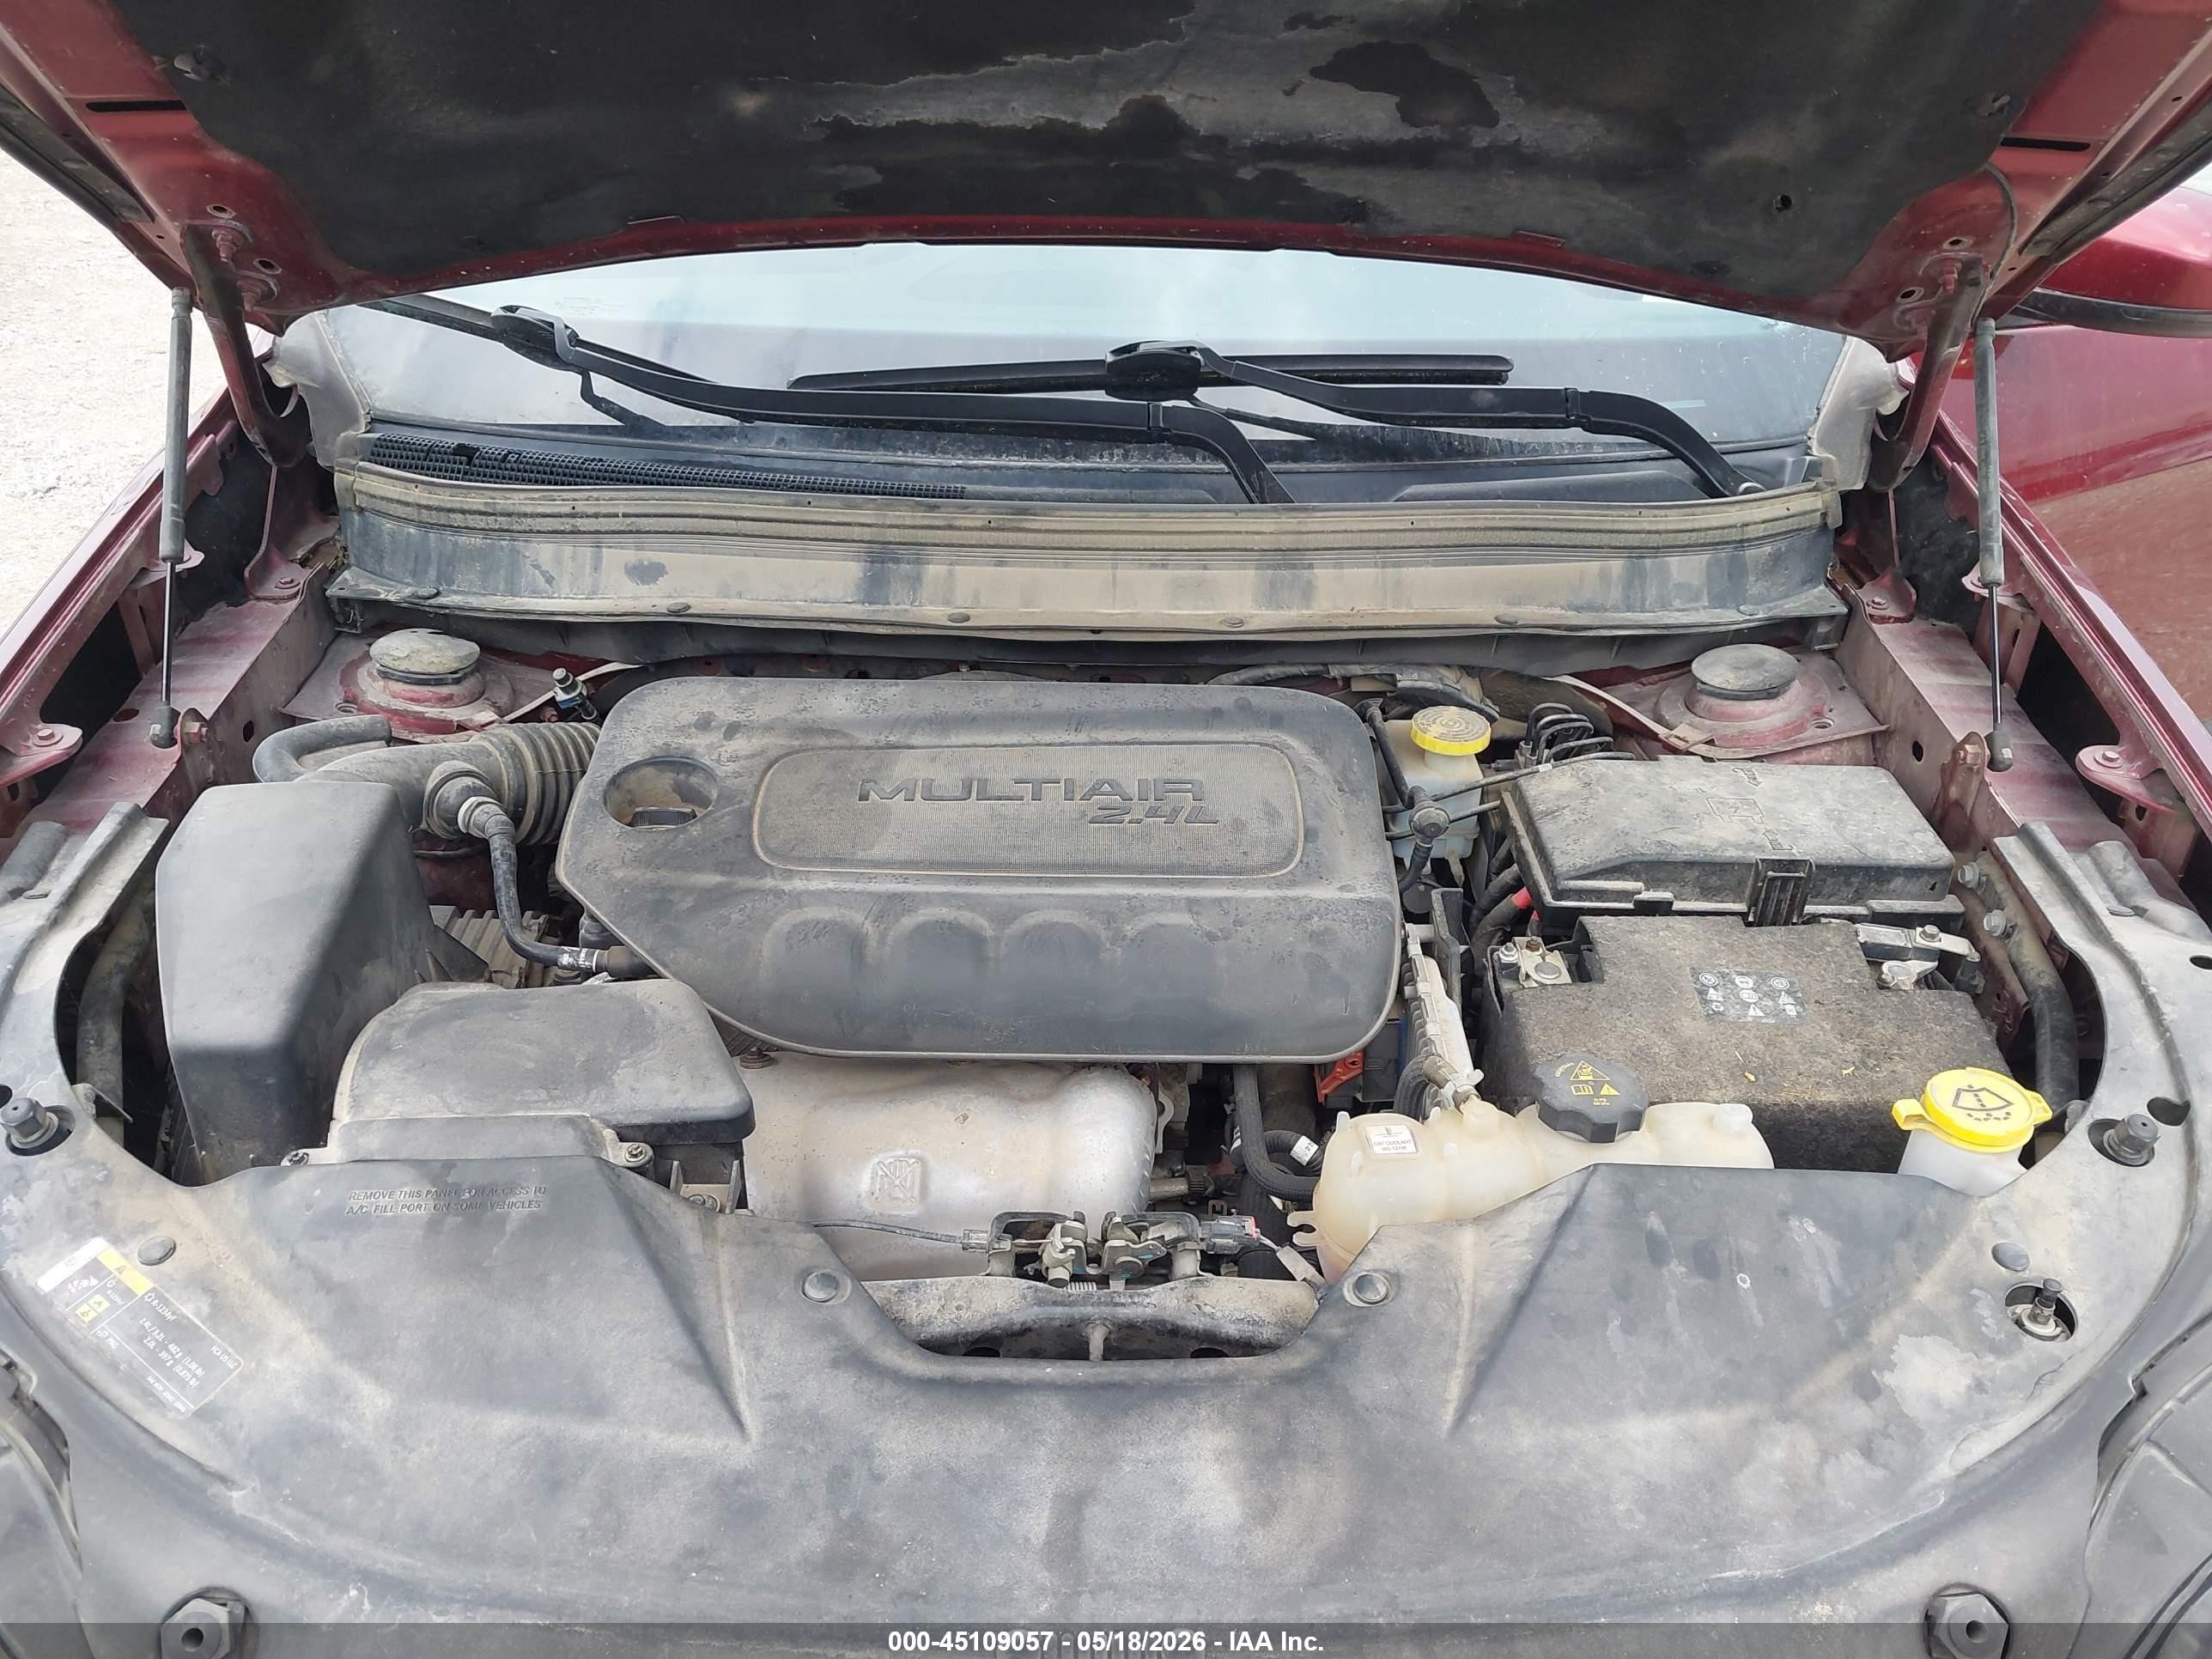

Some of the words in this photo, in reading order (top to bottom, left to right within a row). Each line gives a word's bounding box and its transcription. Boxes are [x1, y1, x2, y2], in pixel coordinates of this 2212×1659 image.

[858, 778, 1204, 802] MULTIAIR
[1089, 805, 1219, 824] 2.4L
[349, 1190, 395, 1200] REMOVE
[398, 1188, 422, 1199] THIS
[425, 1188, 457, 1198] PANEL
[463, 1187, 484, 1197] FOR
[487, 1187, 529, 1196] ACCESS
[532, 1186, 547, 1195] TO
[346, 1204, 368, 1215] A/C
[374, 1203, 395, 1213] FILL
[399, 1203, 429, 1212] PORT
[433, 1202, 450, 1212] ON
[453, 1201, 481, 1211] SOME
[489, 1200, 542, 1210] VEHICLES
[150, 1298, 178, 1322] R-1234yf
[106, 1337, 118, 1350] PAG
